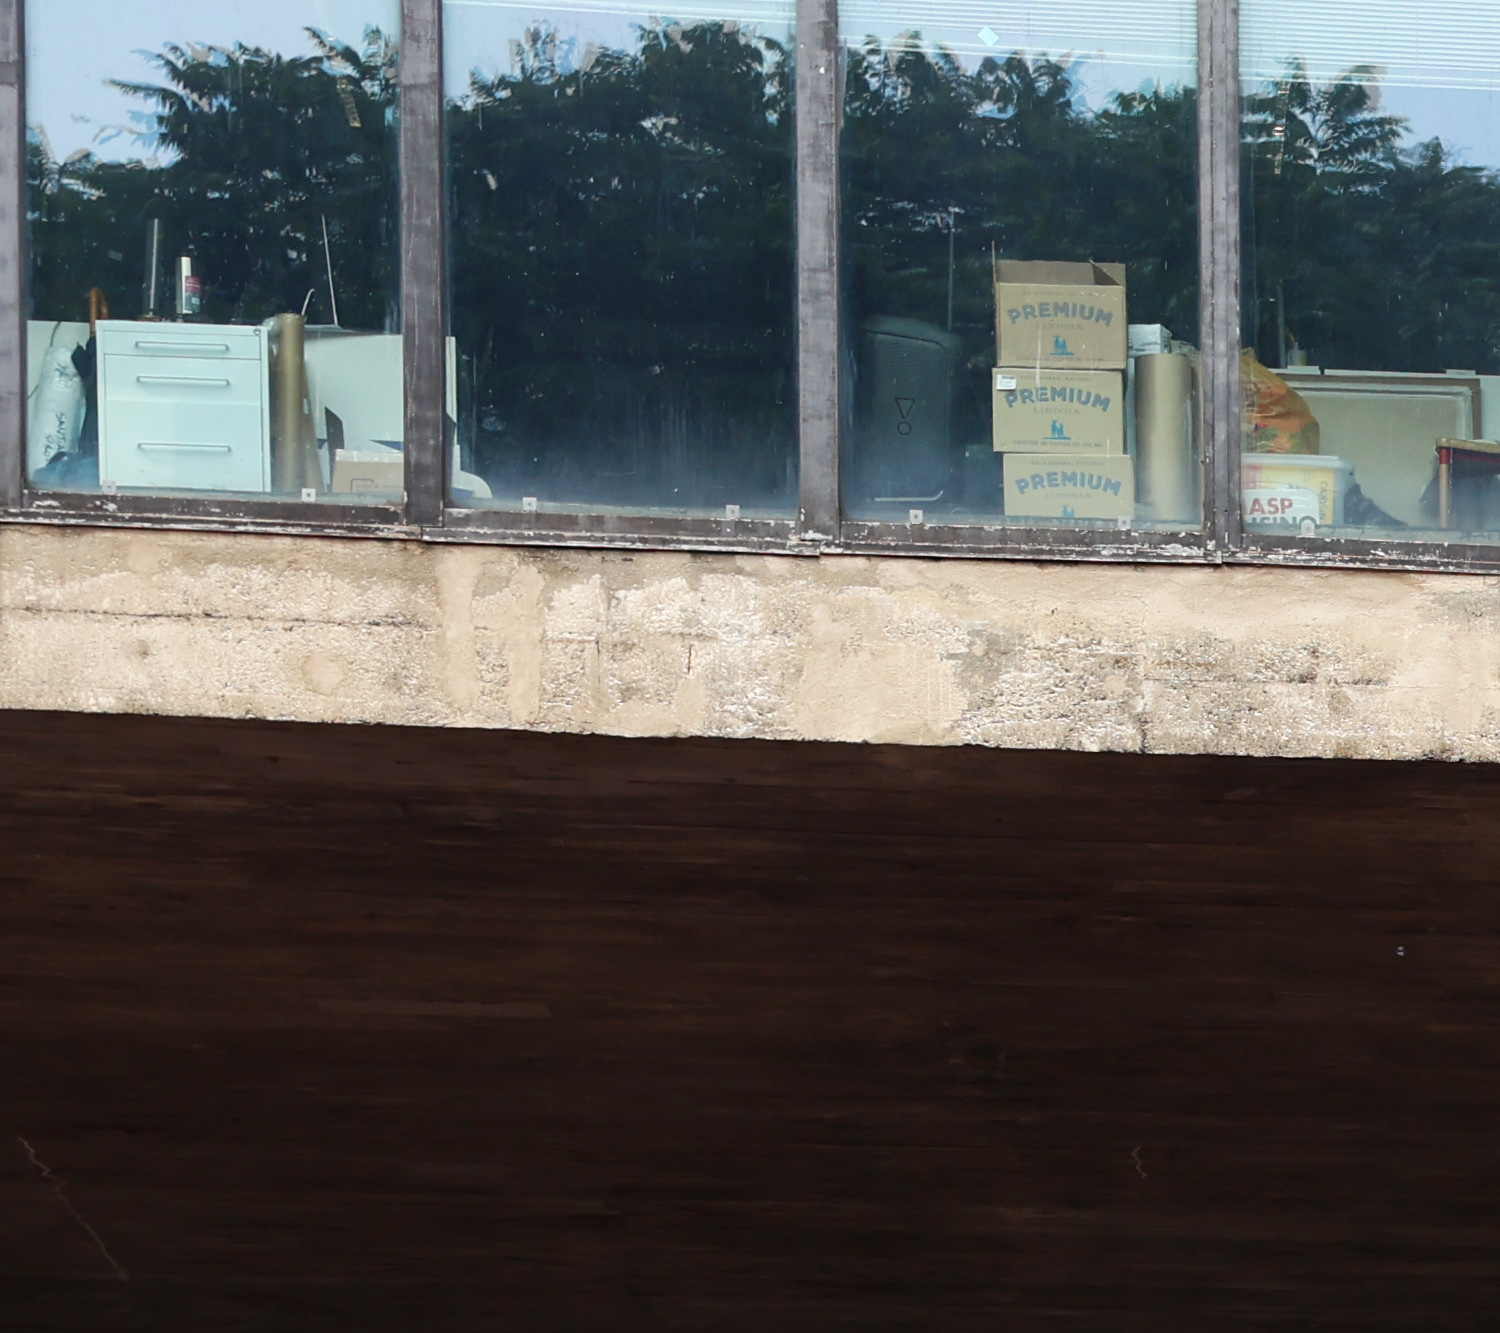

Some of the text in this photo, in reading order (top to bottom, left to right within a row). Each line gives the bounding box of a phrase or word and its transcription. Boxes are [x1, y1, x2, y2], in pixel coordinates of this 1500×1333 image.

[1007, 301, 1113, 327] PREMIUM
[1004, 386, 1111, 412] PREMIUM
[1015, 471, 1122, 496] PREMIUM
